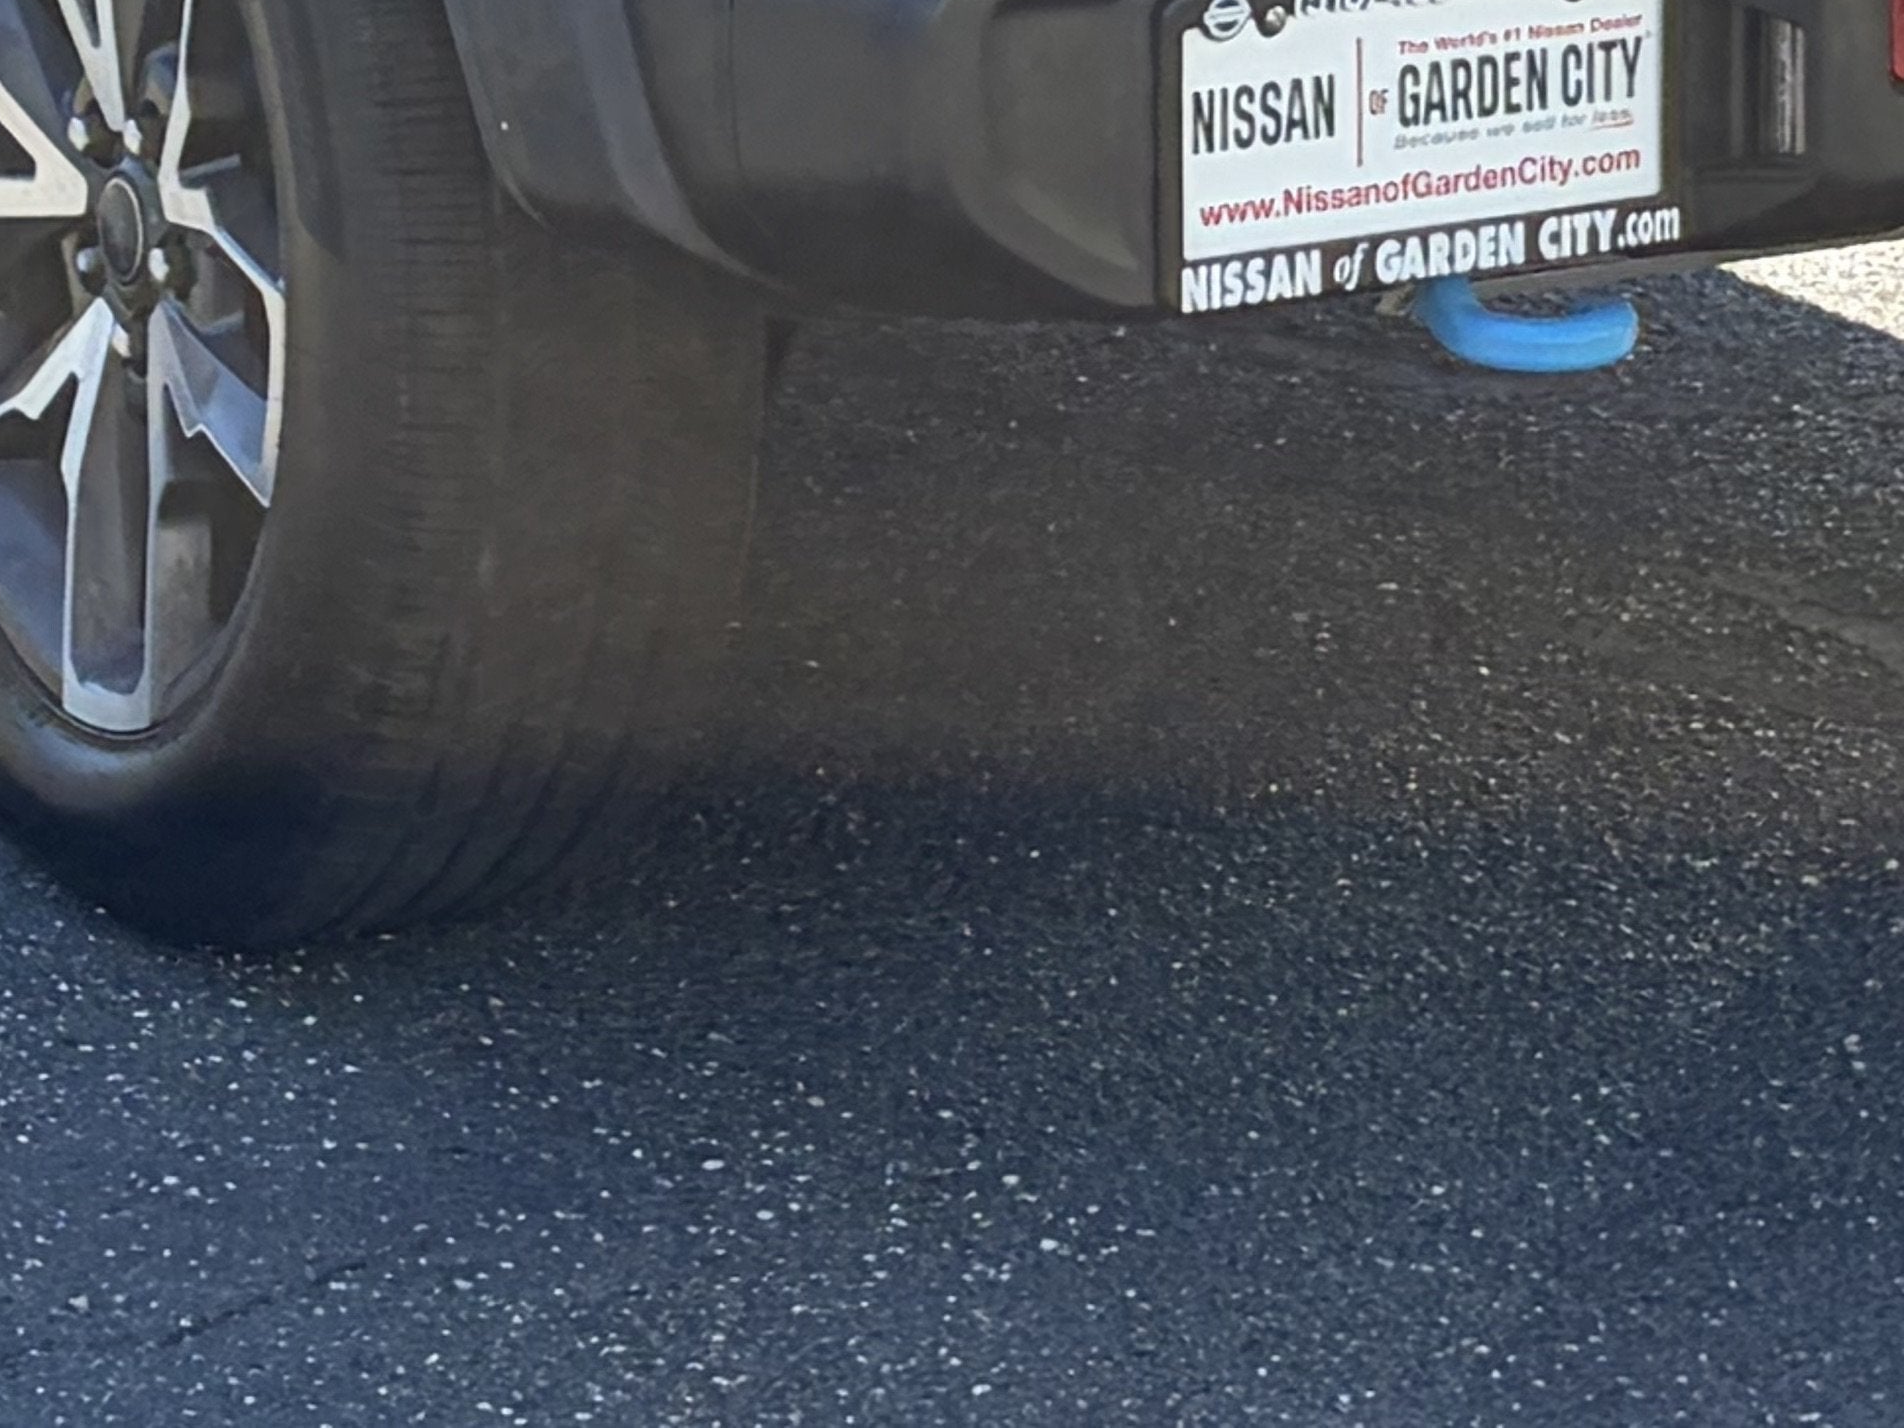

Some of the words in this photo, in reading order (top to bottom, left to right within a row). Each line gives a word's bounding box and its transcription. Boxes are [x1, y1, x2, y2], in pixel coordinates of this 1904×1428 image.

[1398, 40, 1429, 55] The
[1527, 21, 1585, 40] Nissan
[1590, 12, 1643, 33] Dealer
[1191, 73, 1336, 155] NISSAN
[1369, 88, 1389, 116] OF
[1397, 46, 1549, 128] GARDEN
[1560, 35, 1643, 108] CITY
[1199, 147, 1642, 228] www.NissanofGardenCity.com
[1180, 248, 1323, 314] NISSAN
[1333, 242, 1370, 292] of
[1375, 221, 1526, 283] GARDEN
[1537, 205, 1681, 262] CITY.com
